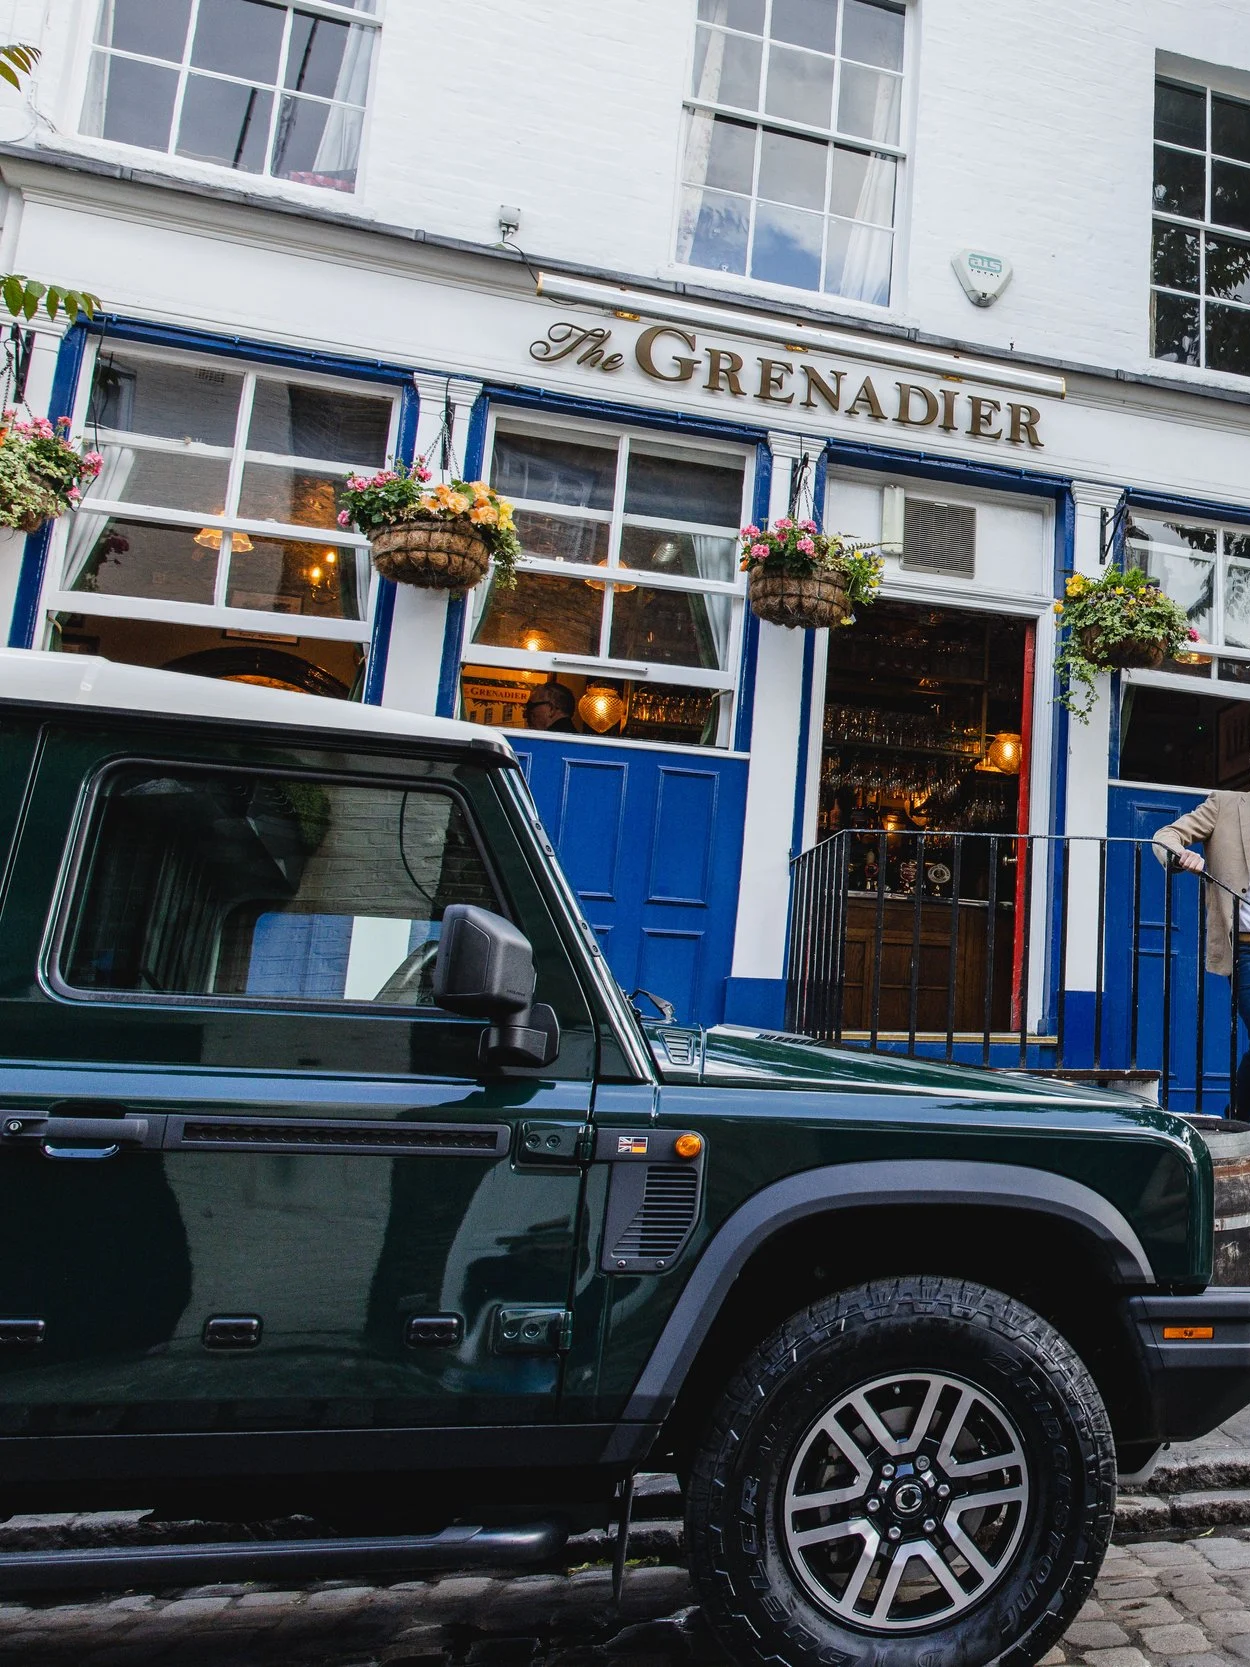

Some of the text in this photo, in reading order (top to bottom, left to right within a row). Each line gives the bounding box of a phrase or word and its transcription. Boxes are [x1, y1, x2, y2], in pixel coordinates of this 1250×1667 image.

[971, 269, 1000, 278] TOTAL
[529, 322, 1045, 448] The GRENADIER
[470, 687, 527, 700] GRENADIER
